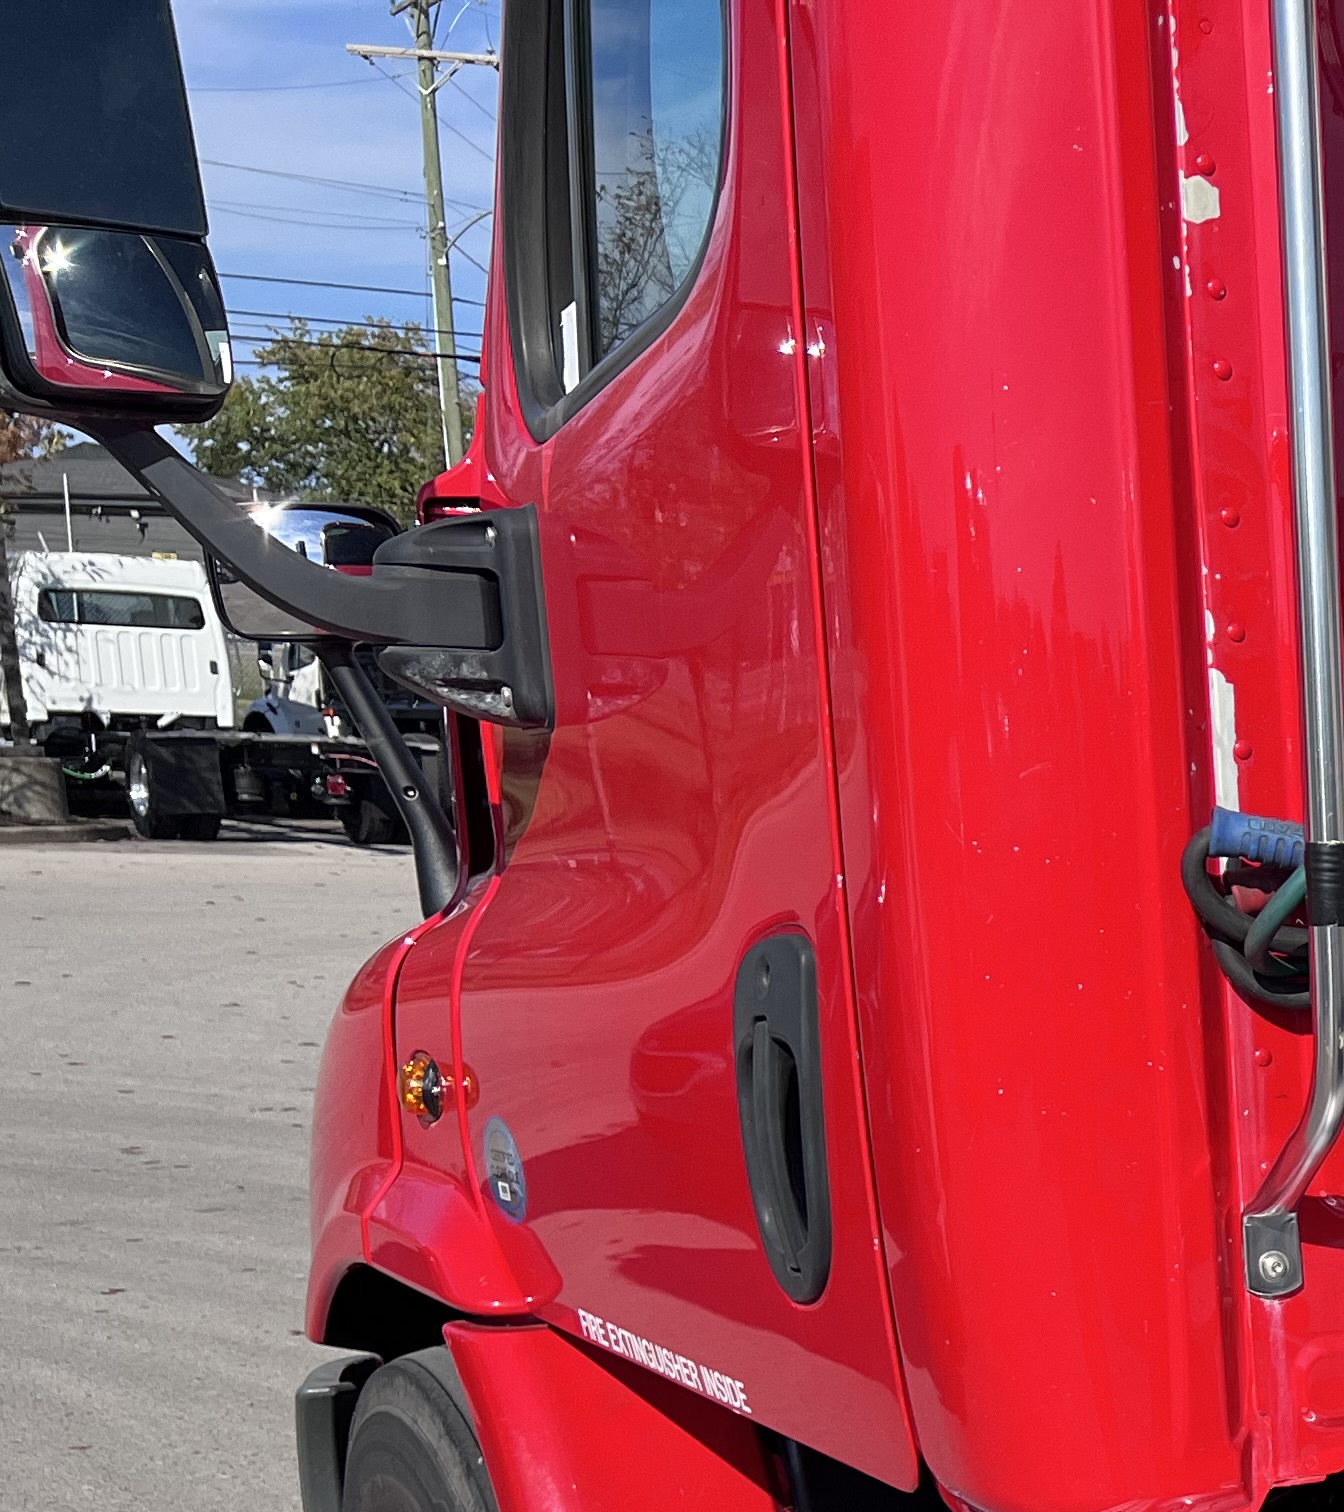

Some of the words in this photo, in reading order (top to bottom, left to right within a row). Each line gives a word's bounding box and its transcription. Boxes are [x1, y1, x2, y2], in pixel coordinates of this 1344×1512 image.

[578, 1308, 609, 1347] FIRE
[606, 1322, 703, 1391] EXTINGUISHER
[699, 1364, 752, 1413] INSIDE
